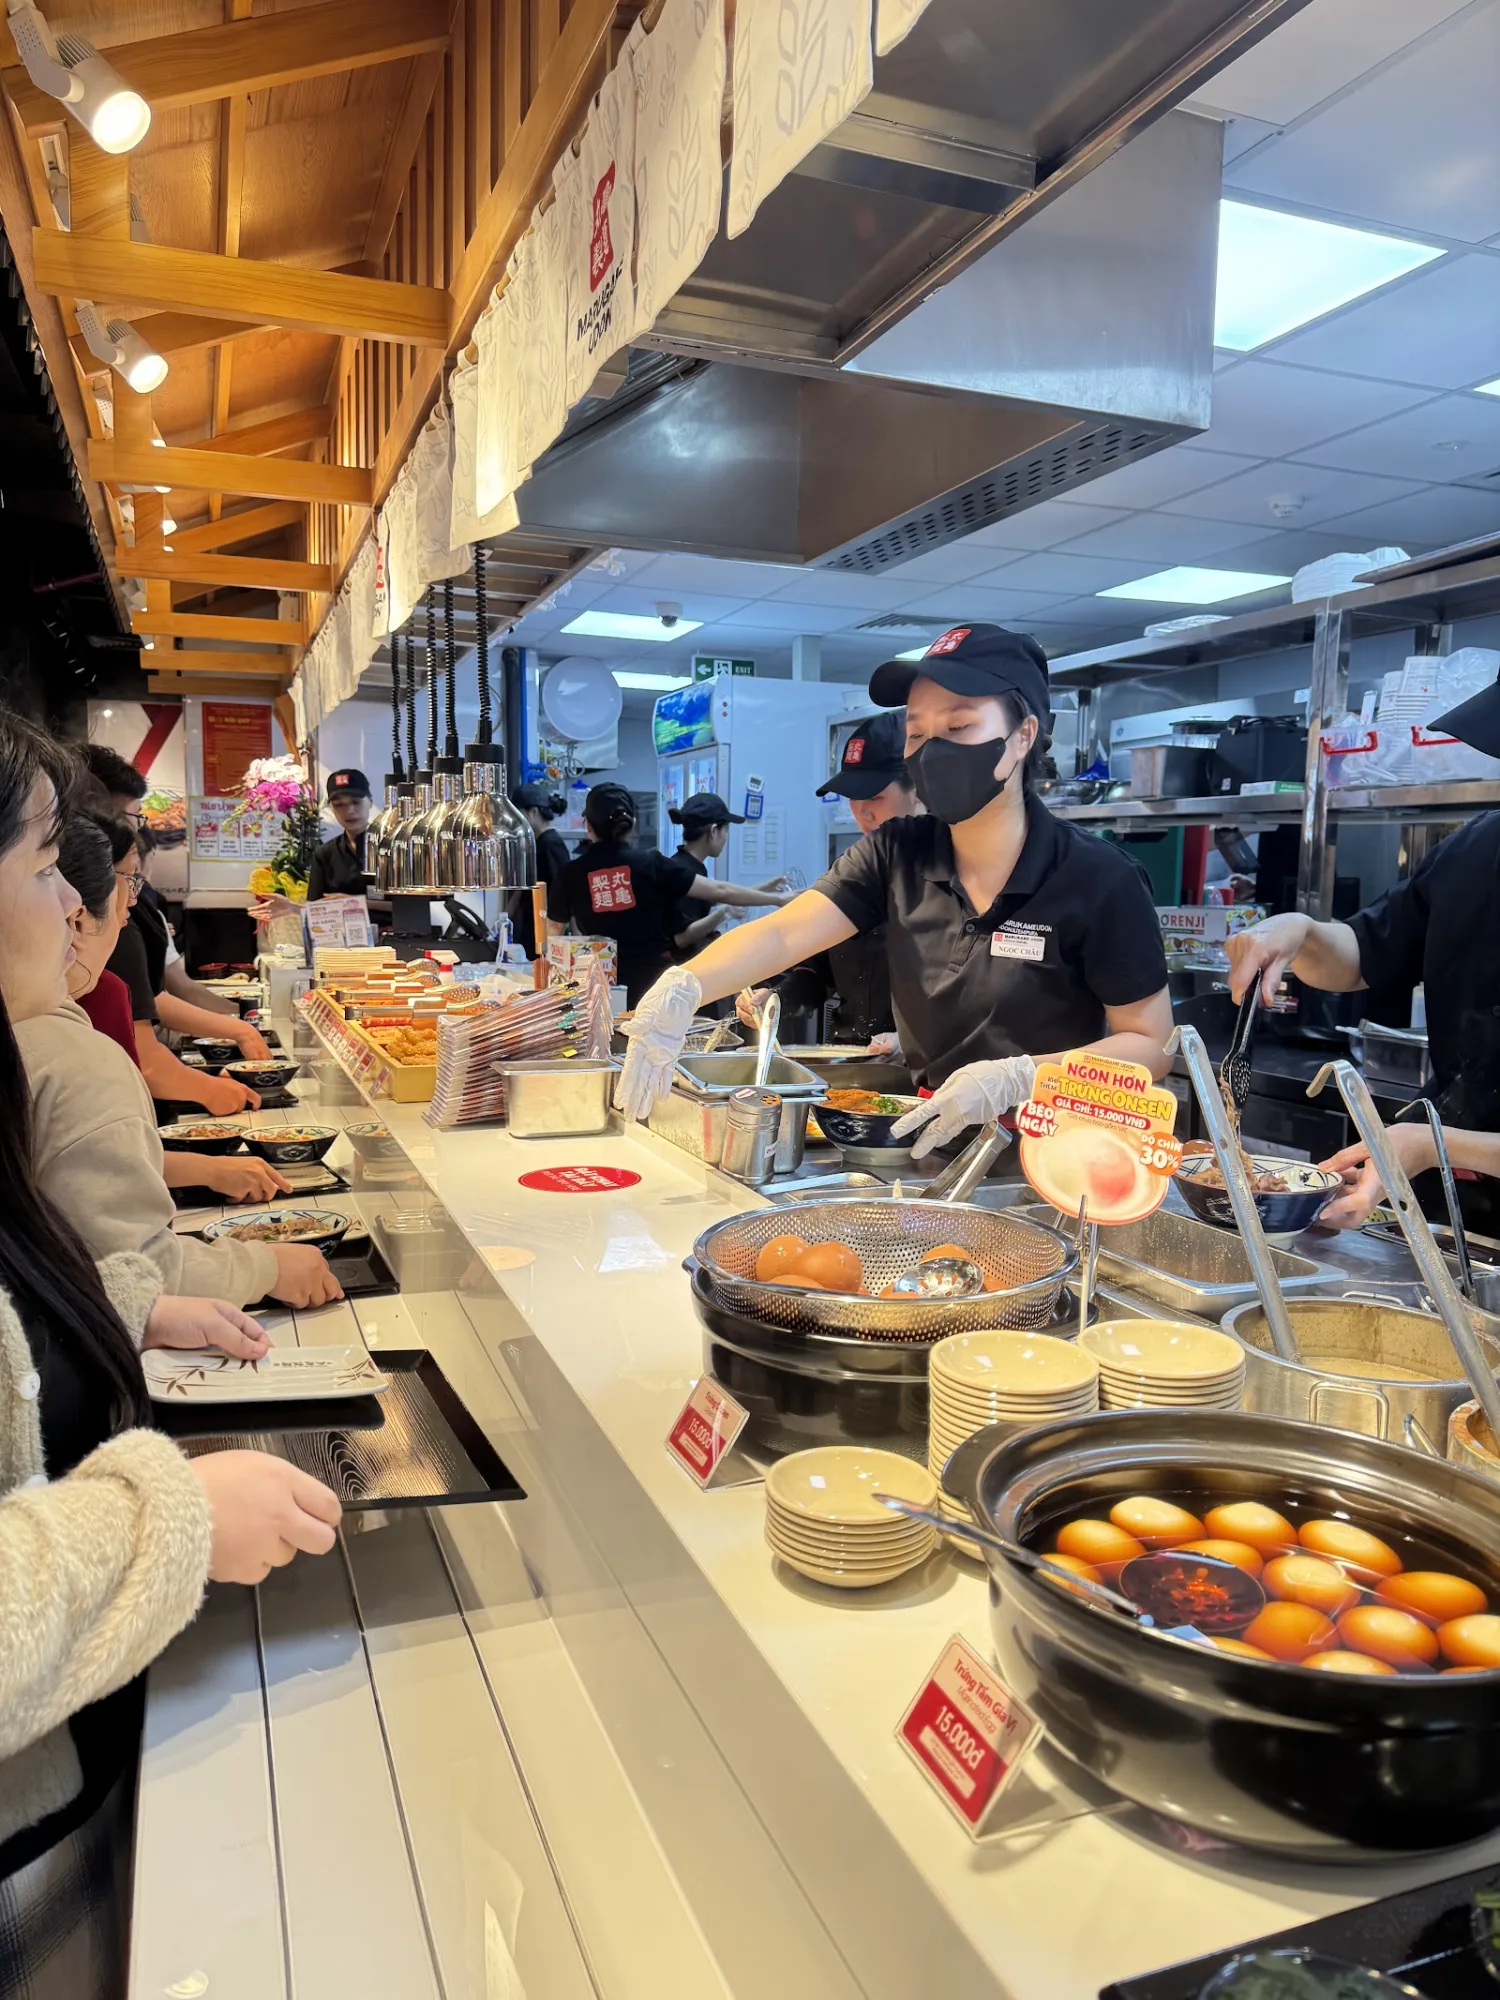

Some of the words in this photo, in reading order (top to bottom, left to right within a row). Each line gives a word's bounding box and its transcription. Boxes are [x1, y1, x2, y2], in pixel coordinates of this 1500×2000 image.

[588, 301, 612, 355] UDON
[735, 666, 752, 674] EXIT
[999, 945, 1019, 955] NGỌC
[1067, 1062, 1110, 1084] NGON
[1112, 1073, 1147, 1093] HƠN
[1026, 1101, 1055, 1121] BÉO
[1055, 1098, 1072, 1110] GIÁ
[1093, 1107, 1125, 1123] 15.000
[1124, 1114, 1147, 1130] VNĐ
[1058, 1076, 1112, 1106] TRỨNG
[1112, 1090, 1173, 1121] ONSEN
[1139, 1145, 1179, 1169] 30%
[1157, 1137, 1184, 1153] CHÍN
[954, 1659, 977, 1691] Trứng
[992, 1701, 1007, 1724] Gia
[1005, 1717, 1018, 1736] Vị
[935, 1705, 986, 1770] 15.000đ
